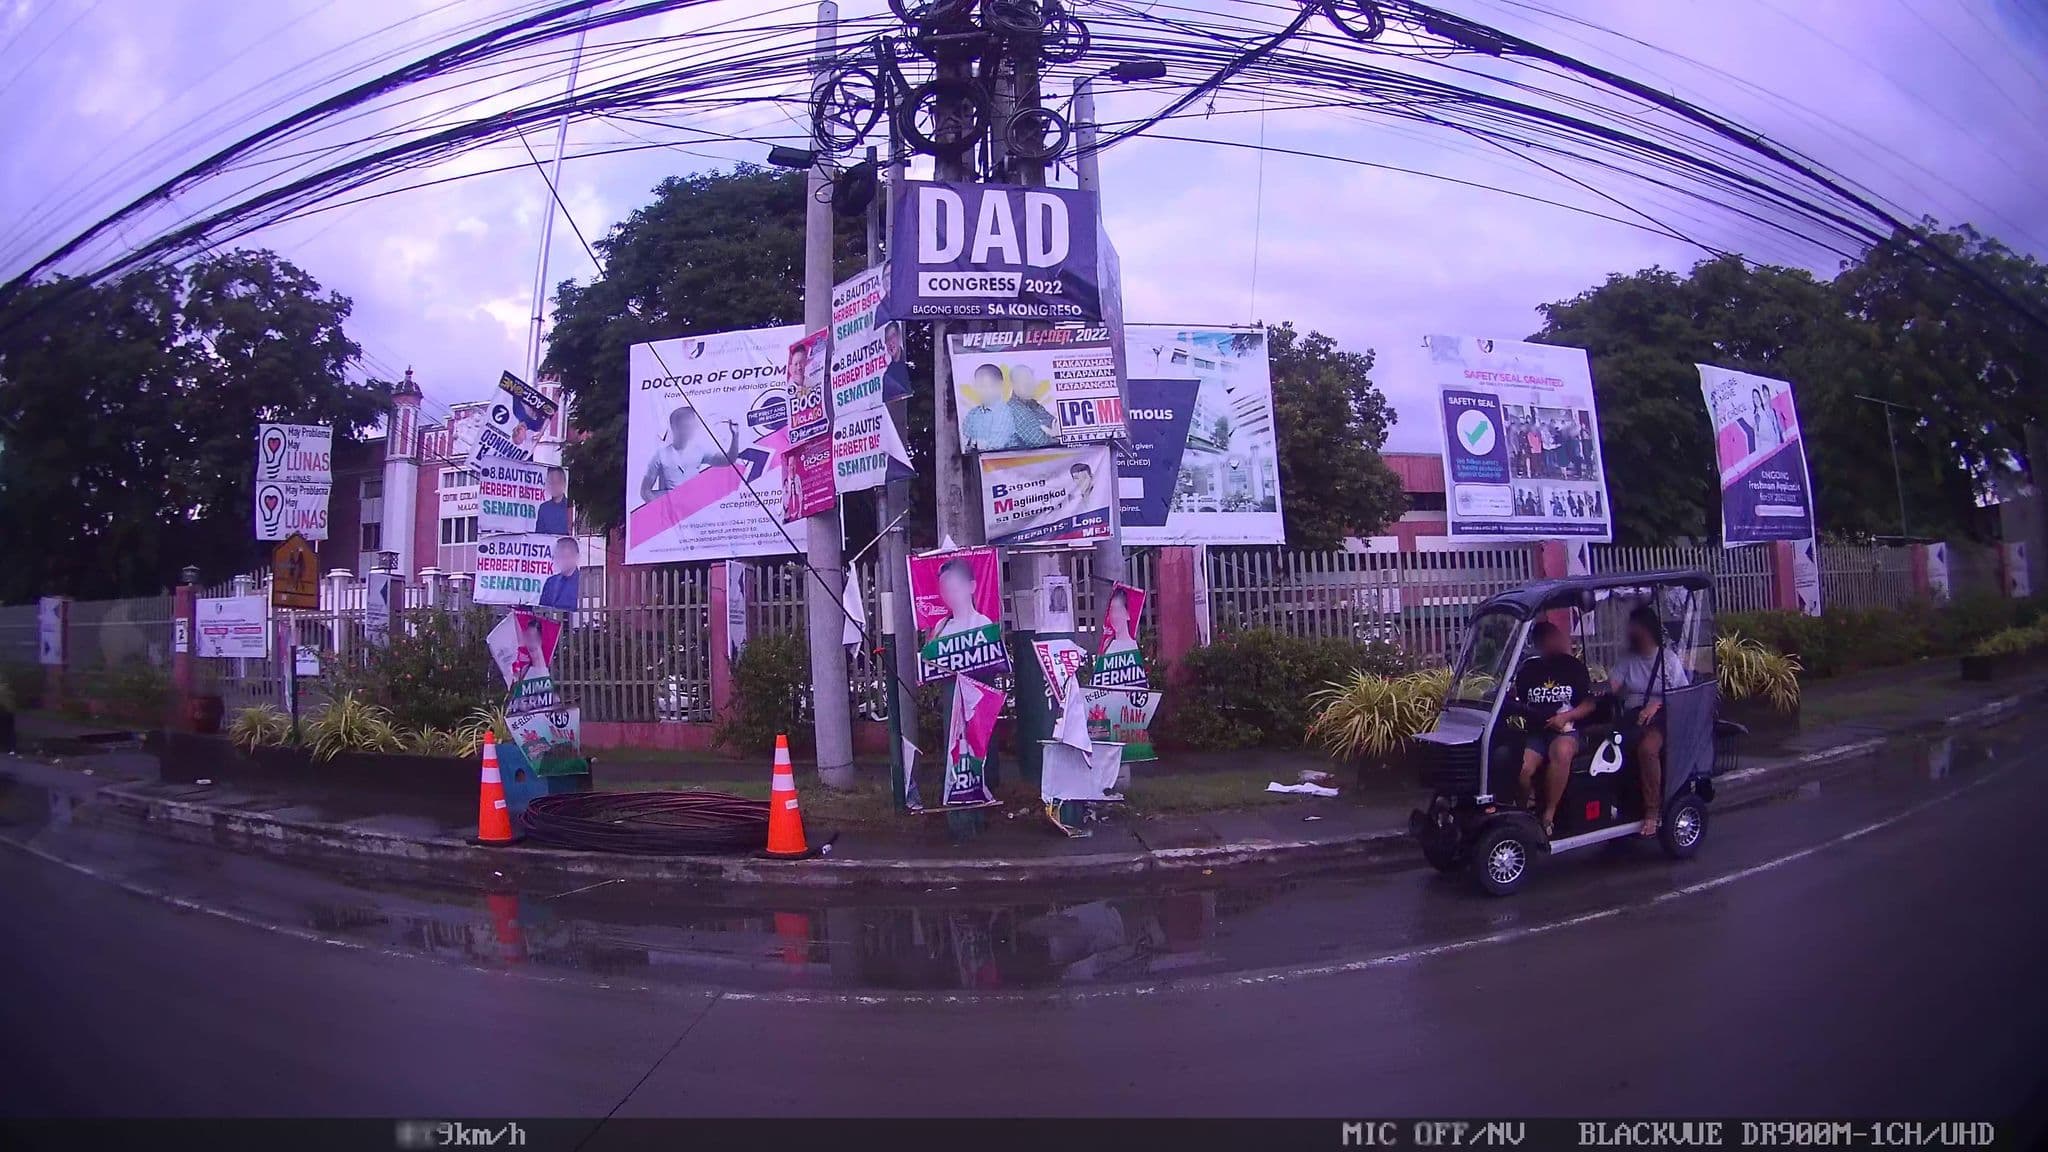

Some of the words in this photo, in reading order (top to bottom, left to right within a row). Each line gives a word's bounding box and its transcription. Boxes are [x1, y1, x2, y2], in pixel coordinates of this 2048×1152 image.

[919, 187, 1070, 268] DAD
[928, 278, 1015, 291] CONGRESS
[1025, 280, 1063, 294] 2022
[834, 300, 860, 323] HERBERT
[913, 305, 952, 314] BAGONG
[954, 306, 980, 314] BOSES
[988, 304, 1004, 314] SA
[1009, 304, 1082, 316] KONGRESO
[963, 333, 980, 347] WE
[982, 331, 1013, 349] NEED
[1013, 331, 1024, 348] A
[1076, 328, 1110, 342] 2022.
[642, 373, 703, 390] DOCTOR
[707, 371, 729, 383] OF
[732, 366, 786, 381] OPTOM
[832, 365, 864, 389] HERBERT
[1464, 370, 1498, 382] SAFETY
[1500, 373, 1522, 383] SEAL
[1524, 375, 1564, 388] GRANTED
[724, 384, 736, 393] the
[837, 376, 880, 407] SENATOR
[1448, 396, 1476, 406] SAFETY
[1478, 398, 1496, 408] SEAL
[1129, 408, 1174, 420] mous
[288, 427, 300, 438] May
[302, 427, 330, 439] Problema
[287, 439, 300, 450] May
[834, 438, 867, 458] HERBERT
[1135, 443, 1154, 451] given
[286, 451, 330, 472] LUNAS
[838, 453, 886, 477] SENATOR
[1126, 458, 1150, 468] (CHED)
[285, 484, 298, 496] May
[299, 484, 329, 496] Problema
[480, 481, 517, 498] HERBERT
[520, 486, 546, 502] BISTEK
[992, 479, 1046, 499] Bagong
[285, 498, 298, 510] May
[483, 500, 536, 519] SENATOR
[720, 498, 761, 510] accepting
[994, 488, 1066, 514] Maglilingkod
[285, 510, 327, 530] LUNAS
[996, 515, 1009, 524] sa
[1013, 504, 1055, 520] Distrito
[477, 557, 520, 573] HERBERT
[521, 560, 554, 575] BISTEK
[480, 576, 540, 593] SENATOR
[938, 630, 988, 656] MINA
[924, 642, 1003, 677] FERMIN
[1104, 654, 1136, 670] MINA
[1093, 666, 1146, 687] FERMIN
[522, 678, 552, 696] MINA
[551, 712, 569, 727] 136
